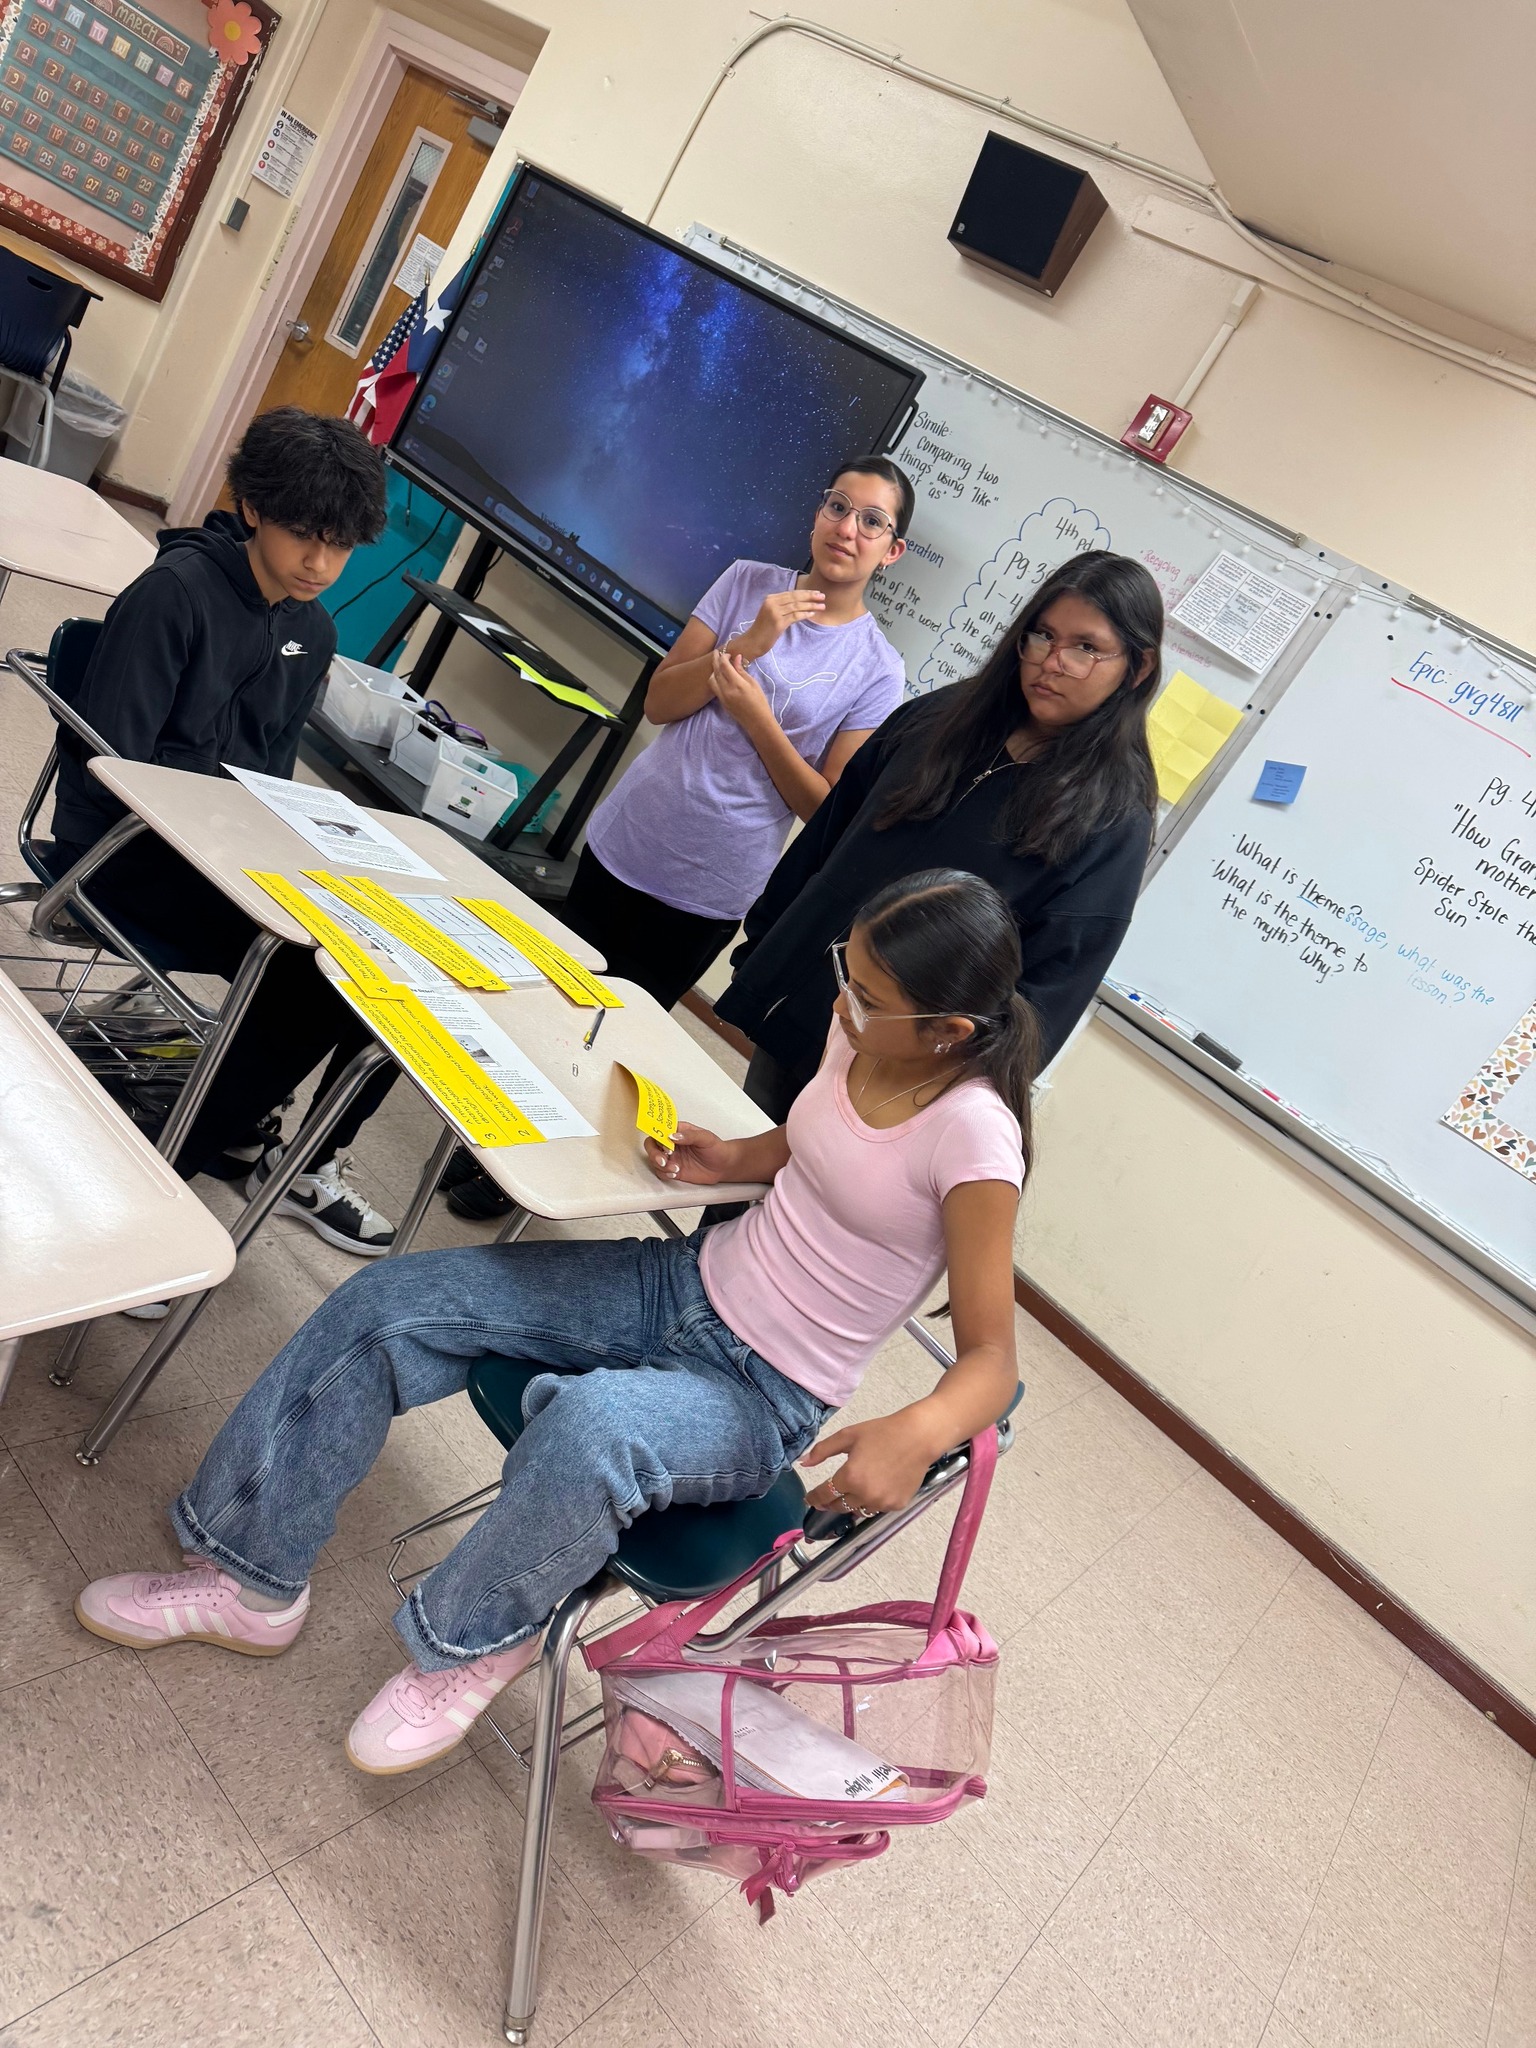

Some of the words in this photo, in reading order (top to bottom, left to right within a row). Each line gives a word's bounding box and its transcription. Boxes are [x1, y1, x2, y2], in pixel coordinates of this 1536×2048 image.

[114, 5, 158, 42] MARCH
[30, 17, 46, 34] 30
[60, 35, 70, 50] 31
[170, 106, 176, 117] 1
[21, 47, 30, 61] 2
[49, 63, 57, 76] 3
[74, 80, 82, 93] 4
[93, 90, 101, 103] 5
[118, 106, 126, 118] 6
[142, 120, 149, 131] 7
[160, 132, 169, 144] 8
[177, 82, 189, 97] SA
[10, 72, 21, 85] 9
[37, 90, 49, 103] 10
[64, 104, 72, 116] 11
[85, 117, 96, 130] 12
[108, 128, 118, 142] 13
[129, 142, 139, 156] 14
[150, 155, 159, 167] 15
[280, 109, 288, 119] IN
[286, 114, 294, 123] AN
[293, 117, 318, 141] EMERGENCY
[0, 97, 14, 112] 16
[27, 112, 38, 125] 17
[51, 126, 62, 141] 18
[73, 140, 86, 153] 19
[93, 153, 109, 168] 20
[116, 165, 127, 178] 21
[137, 178, 153, 192] 22
[12, 137, 28, 151] 24
[38, 152, 52, 166] 25
[61, 164, 77, 178] 26
[85, 178, 100, 191] 27
[105, 188, 119, 202] 28
[131, 203, 145, 217] 29
[913, 411, 953, 437] Simile:
[916, 435, 973, 481] Comparing
[976, 462, 1000, 485] two
[898, 446, 934, 478] things
[936, 471, 965, 499] using
[1055, 516, 1079, 540] 4th
[903, 585, 921, 606] the
[918, 614, 943, 634] word
[961, 617, 980, 638] the
[979, 610, 996, 625] all
[1235, 833, 1282, 875] What
[1282, 867, 1299, 886] is
[1413, 856, 1466, 897] Spider
[1467, 890, 1509, 925] Stole
[1211, 859, 1257, 897] What
[1255, 889, 1273, 906] is
[1273, 900, 1299, 927] the
[1300, 917, 1347, 959] theme
[1352, 952, 1369, 973] to
[1221, 893, 1248, 921] the
[368, 937, 396, 954] Word
[1397, 943, 1438, 973] what
[1440, 969, 1472, 991] was
[1470, 985, 1496, 1006] the
[352, 994, 371, 1009] dug
[365, 1008, 403, 1044] Sawadogo
[373, 1008, 403, 1034] prevent
[396, 1033, 408, 1042] to
[404, 1042, 432, 1066] ground
[449, 1058, 467, 1073] that
[426, 1067, 441, 1078] the
[436, 1078, 448, 1086] in
[425, 1075, 453, 1100] named
[442, 1085, 464, 1104] holes
[462, 1073, 494, 1102] doubted
[448, 1101, 468, 1118] man
[460, 1104, 484, 1125] many
[489, 1102, 513, 1122] Many
[495, 1100, 519, 1121] would
[481, 1131, 498, 1140] 3
[515, 1128, 531, 1136] 2
[652, 1127, 664, 1138] 5
